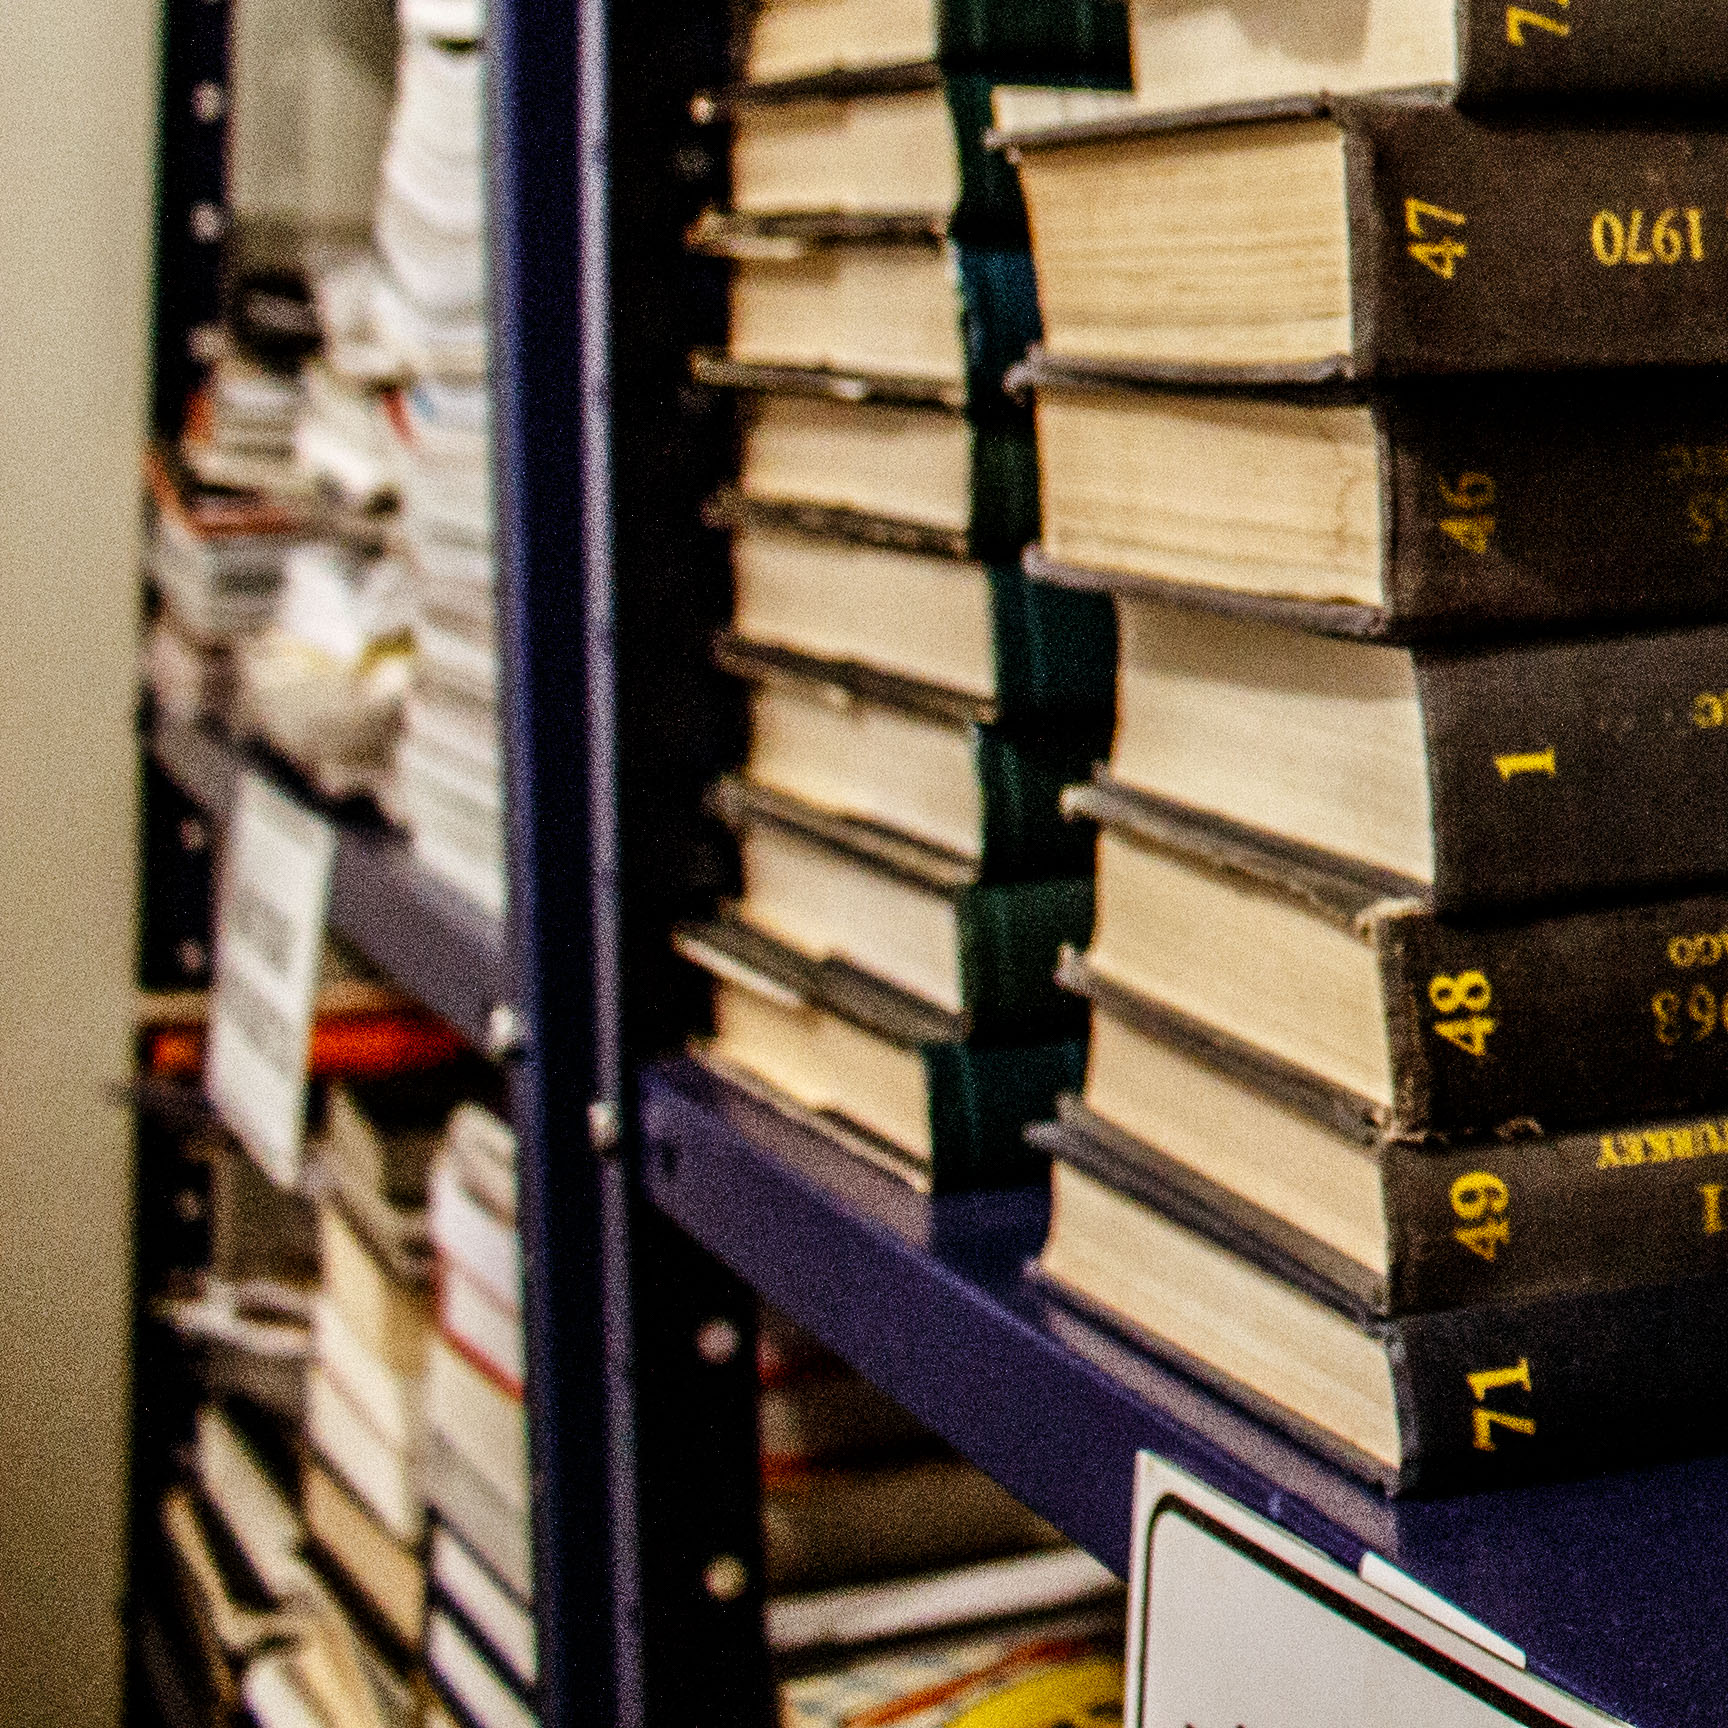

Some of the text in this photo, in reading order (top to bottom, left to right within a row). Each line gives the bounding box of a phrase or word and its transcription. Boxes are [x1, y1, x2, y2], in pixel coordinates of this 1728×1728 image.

[1405, 198, 1468, 280] 47
[1591, 208, 1707, 266] 1970
[1438, 471, 1496, 554] 46
[1495, 747, 1557, 782] 1
[1429, 970, 1497, 1056] 48
[1450, 1172, 1510, 1261] 49
[1467, 1357, 1537, 1452] 71
